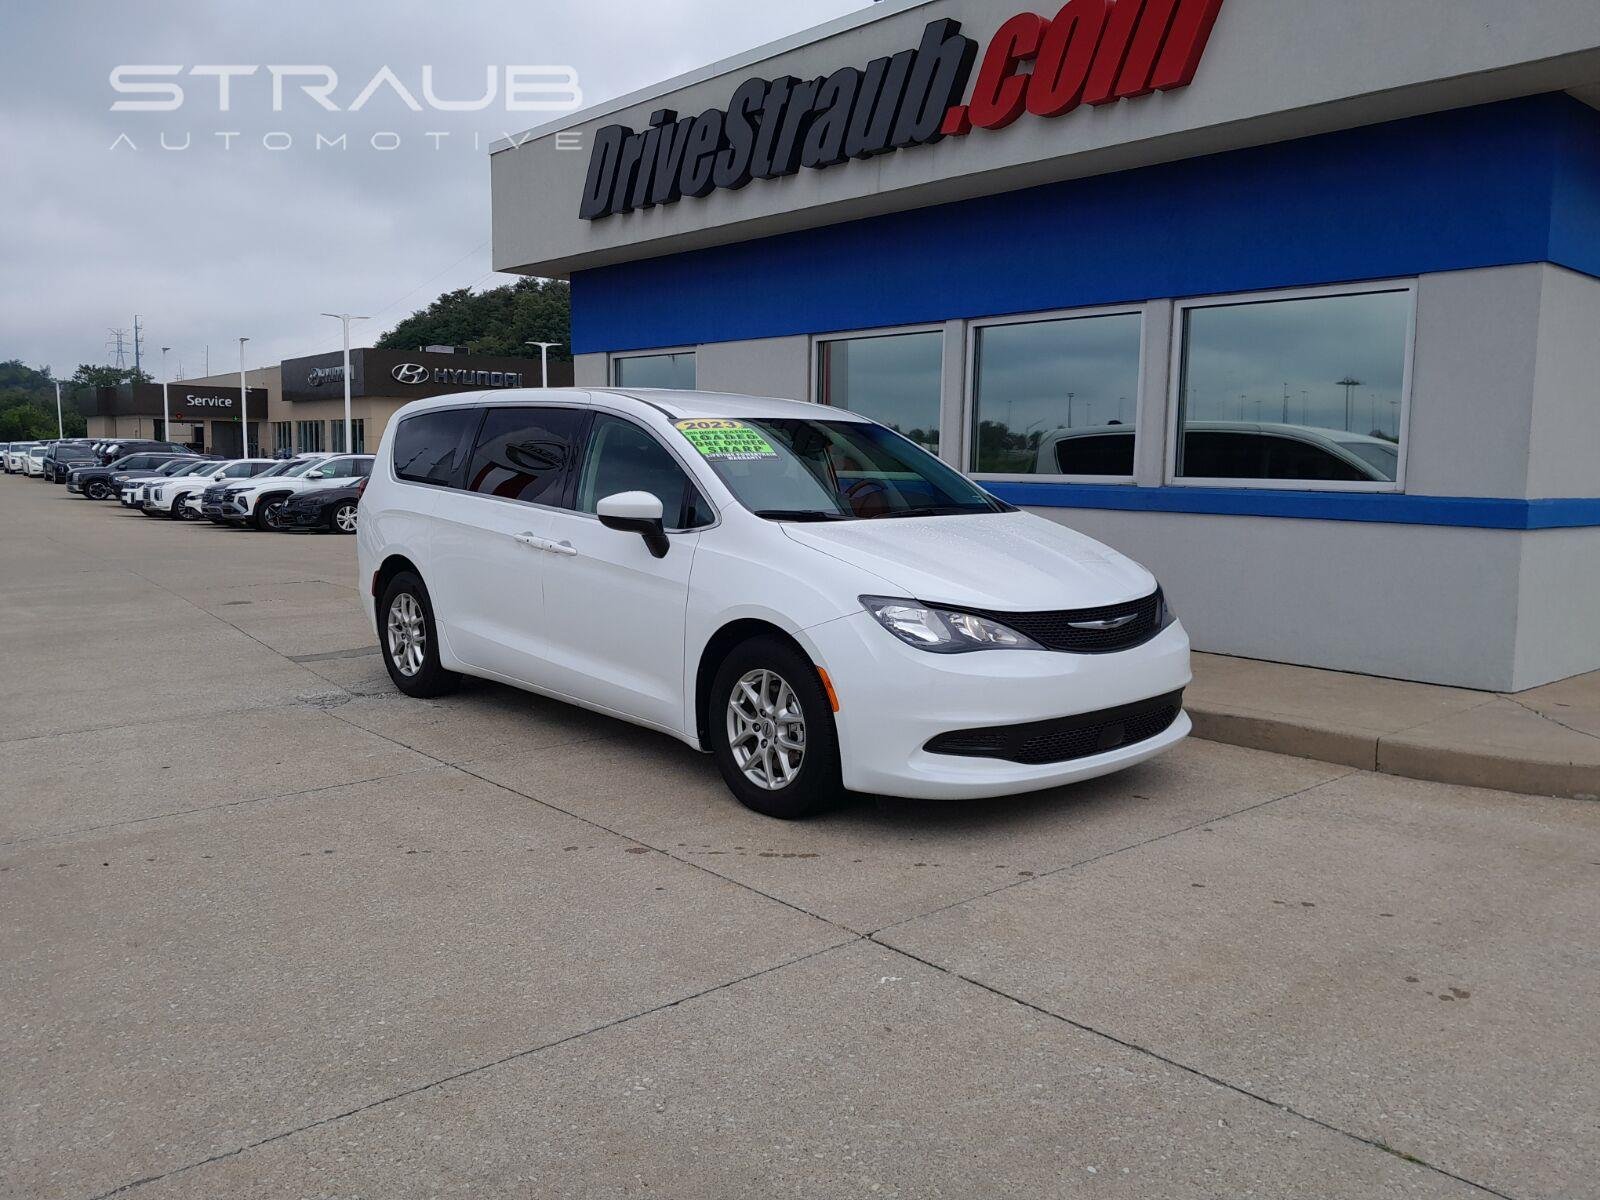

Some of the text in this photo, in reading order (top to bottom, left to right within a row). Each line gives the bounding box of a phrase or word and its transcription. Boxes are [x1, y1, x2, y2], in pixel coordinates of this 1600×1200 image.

[435, 368, 523, 388] HYUNDAI
[186, 394, 232, 407] Service
[684, 421, 736, 429] 2023
